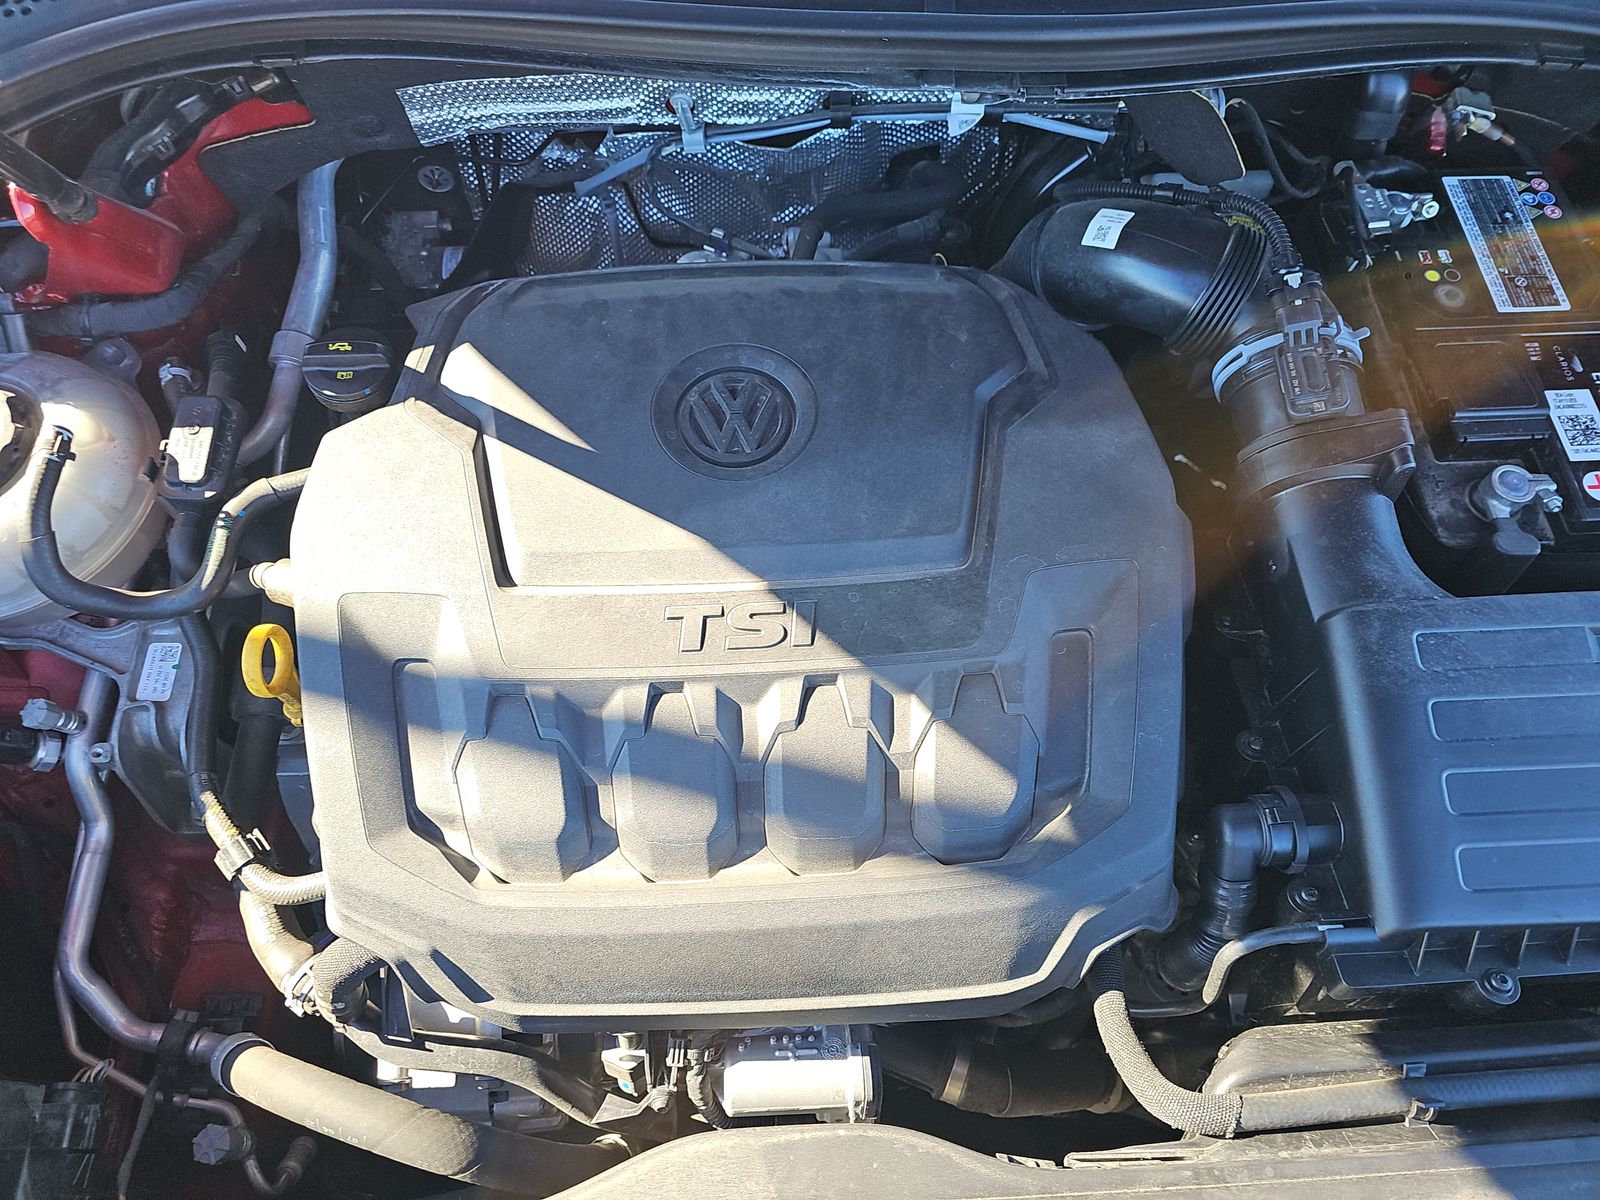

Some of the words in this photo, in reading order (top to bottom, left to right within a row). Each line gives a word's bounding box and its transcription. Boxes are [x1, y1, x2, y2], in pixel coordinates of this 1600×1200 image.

[1552, 345, 1575, 381] CLARIOS
[684, 372, 789, 460] VW
[664, 600, 817, 653] TSI
